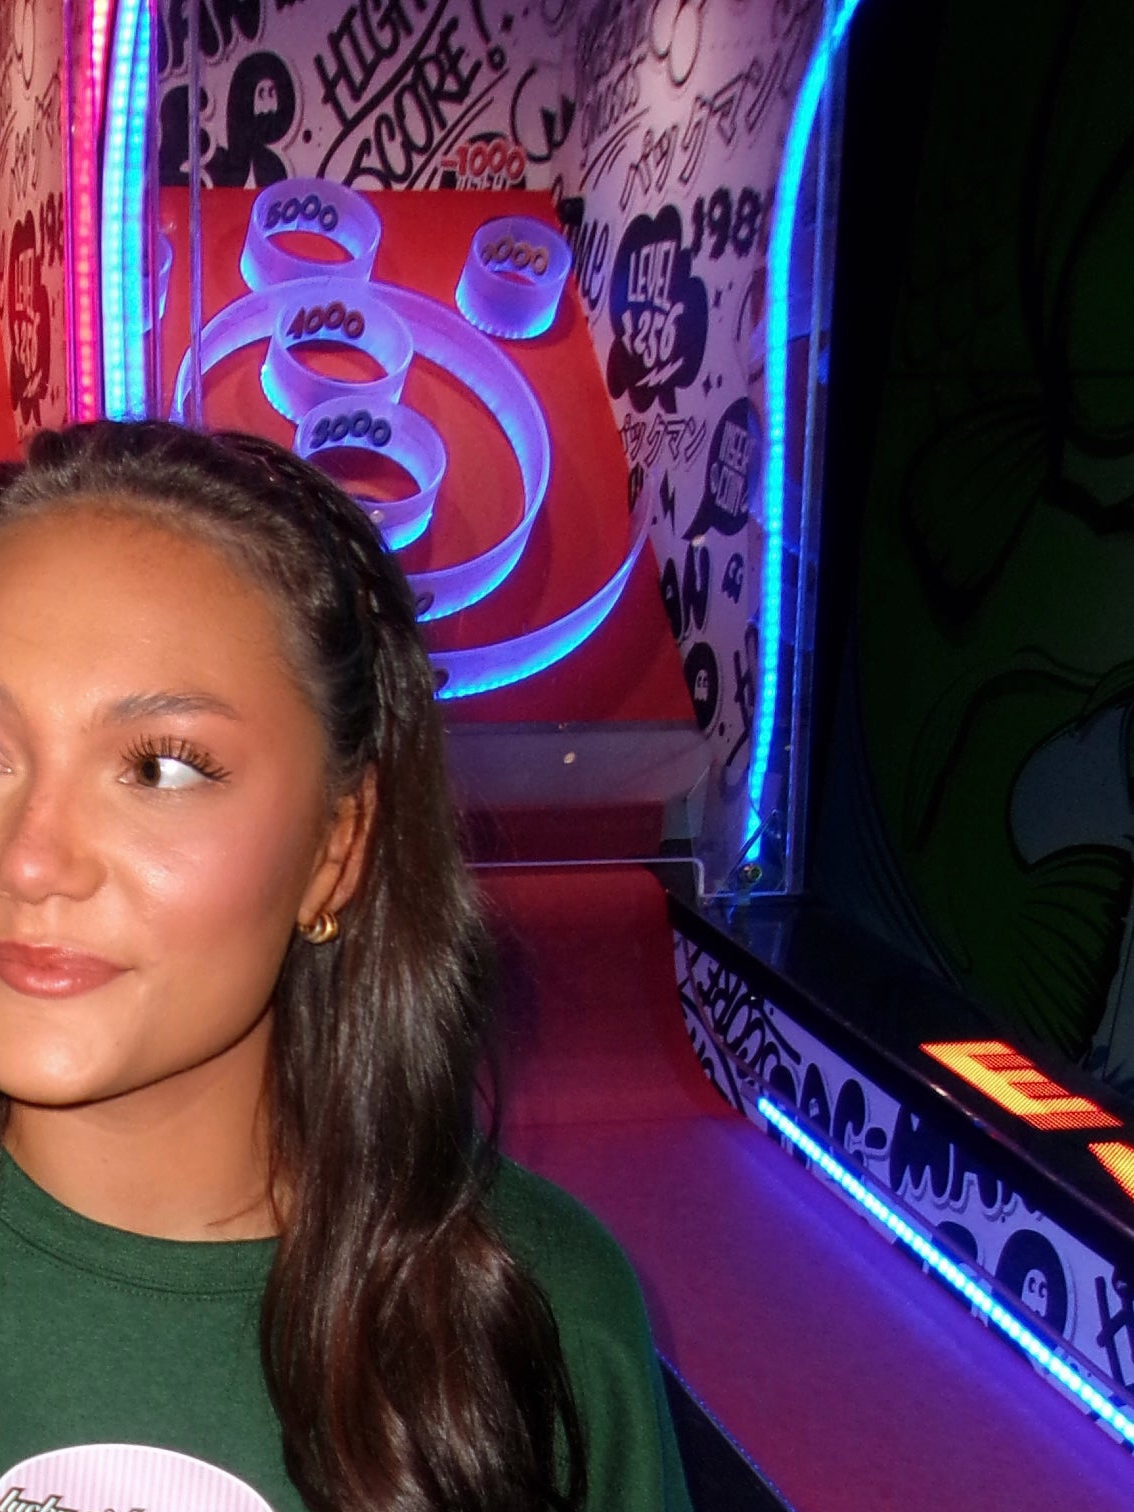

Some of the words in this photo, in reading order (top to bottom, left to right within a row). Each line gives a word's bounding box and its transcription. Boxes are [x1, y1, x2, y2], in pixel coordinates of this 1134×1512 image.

[440, 138, 527, 182] -1000
[263, 194, 338, 232] 5000
[286, 301, 365, 340] 4000
[309, 409, 392, 450] 3000
